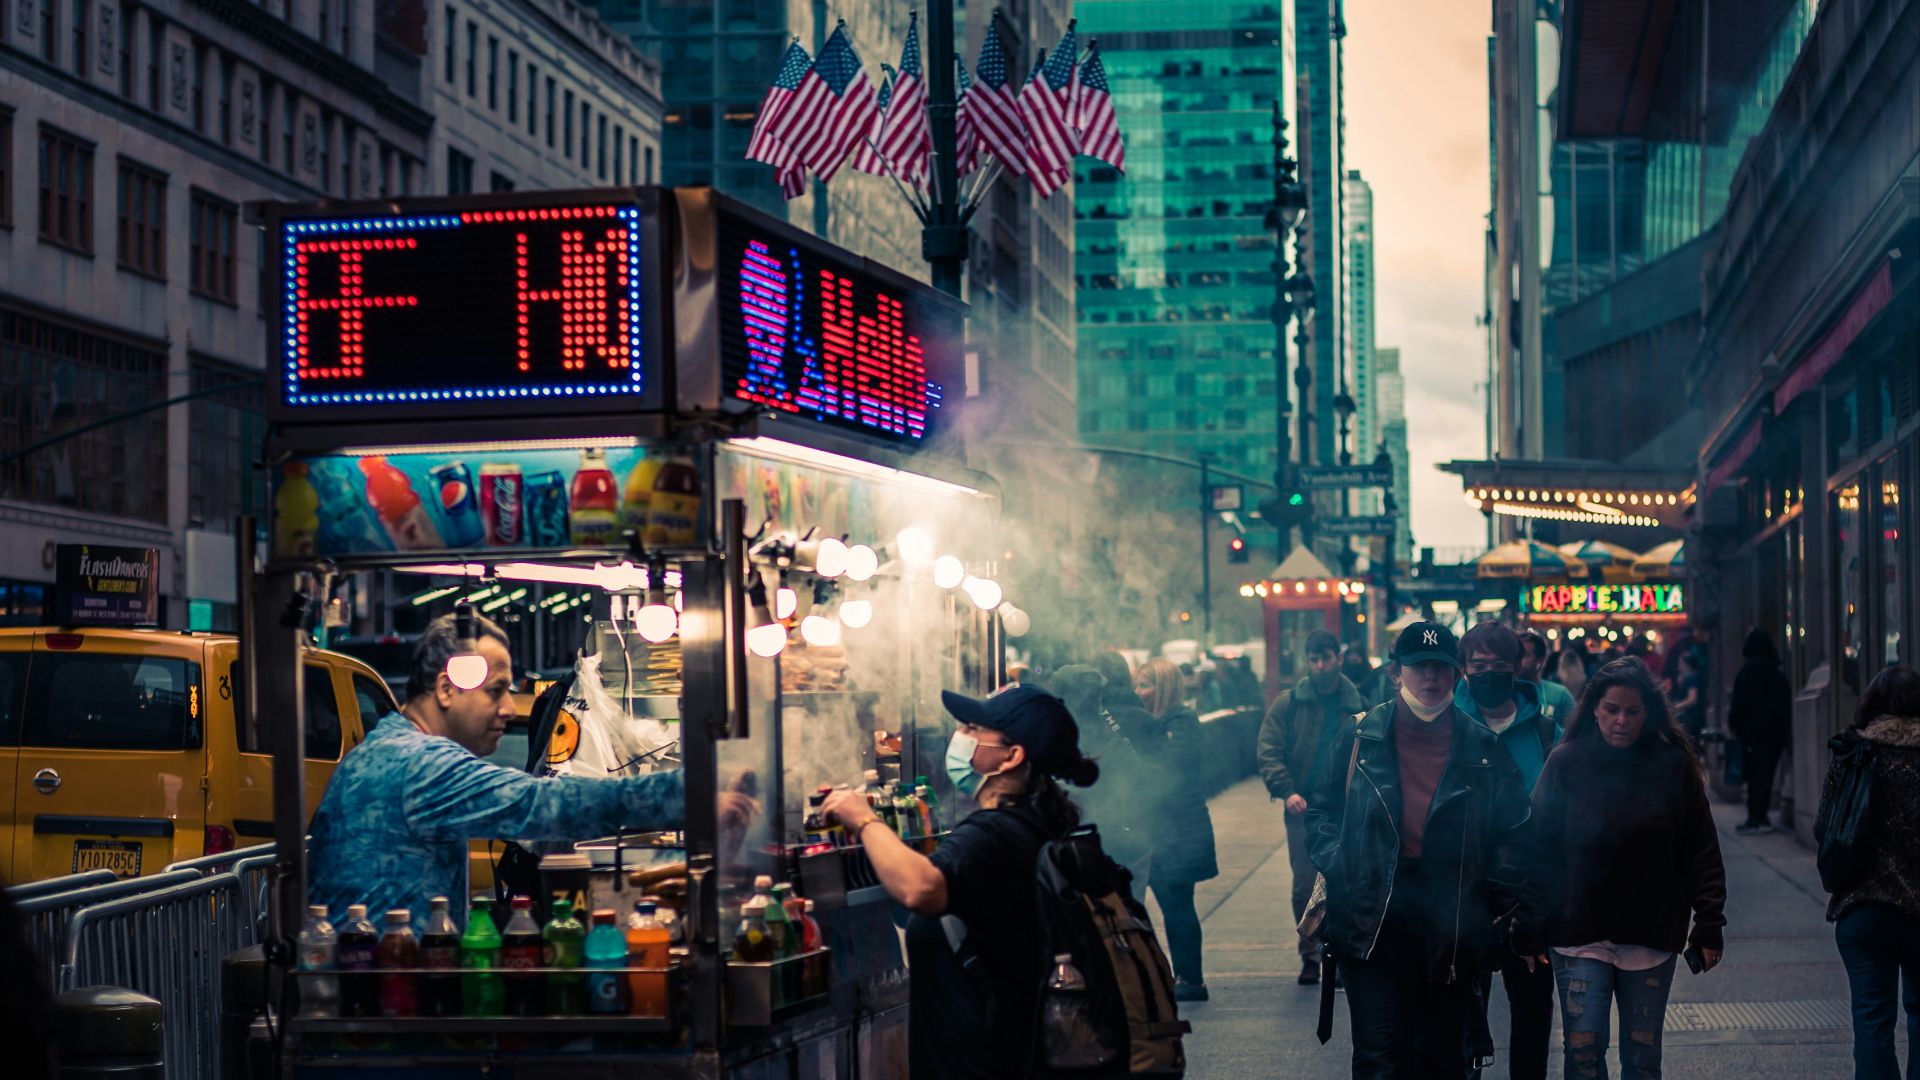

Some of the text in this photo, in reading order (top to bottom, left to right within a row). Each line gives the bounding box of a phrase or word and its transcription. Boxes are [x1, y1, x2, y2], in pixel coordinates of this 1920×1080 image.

[1302, 471, 1390, 485] Vanderbilt Ave
[80, 851, 134, 869] Y101285C
